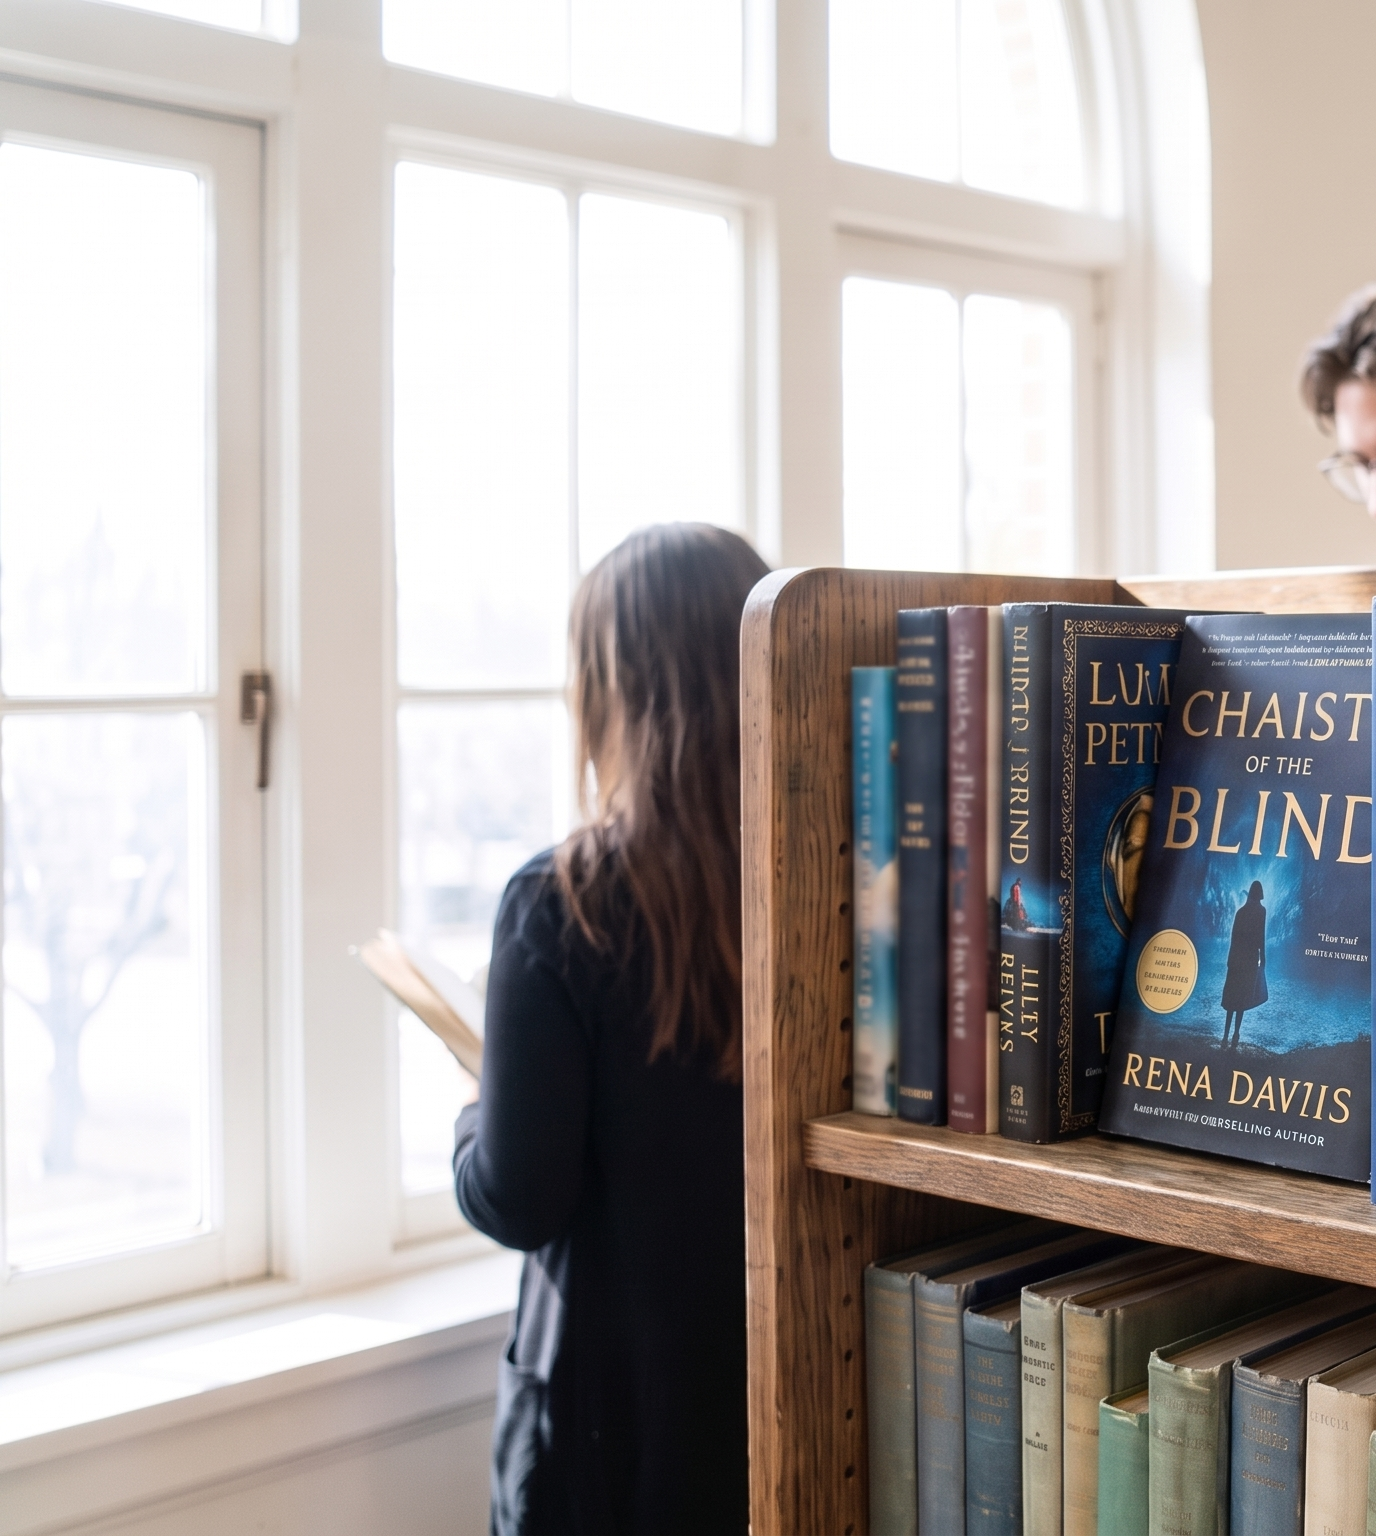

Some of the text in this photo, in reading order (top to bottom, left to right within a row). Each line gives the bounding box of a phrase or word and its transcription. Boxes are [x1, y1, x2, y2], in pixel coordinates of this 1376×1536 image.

[1245, 755, 1314, 776] OF THE
[1162, 785, 1372, 864] BLIND
[1122, 1052, 1214, 1102] RENA
[1274, 1128, 1326, 1147] AUTHOR
